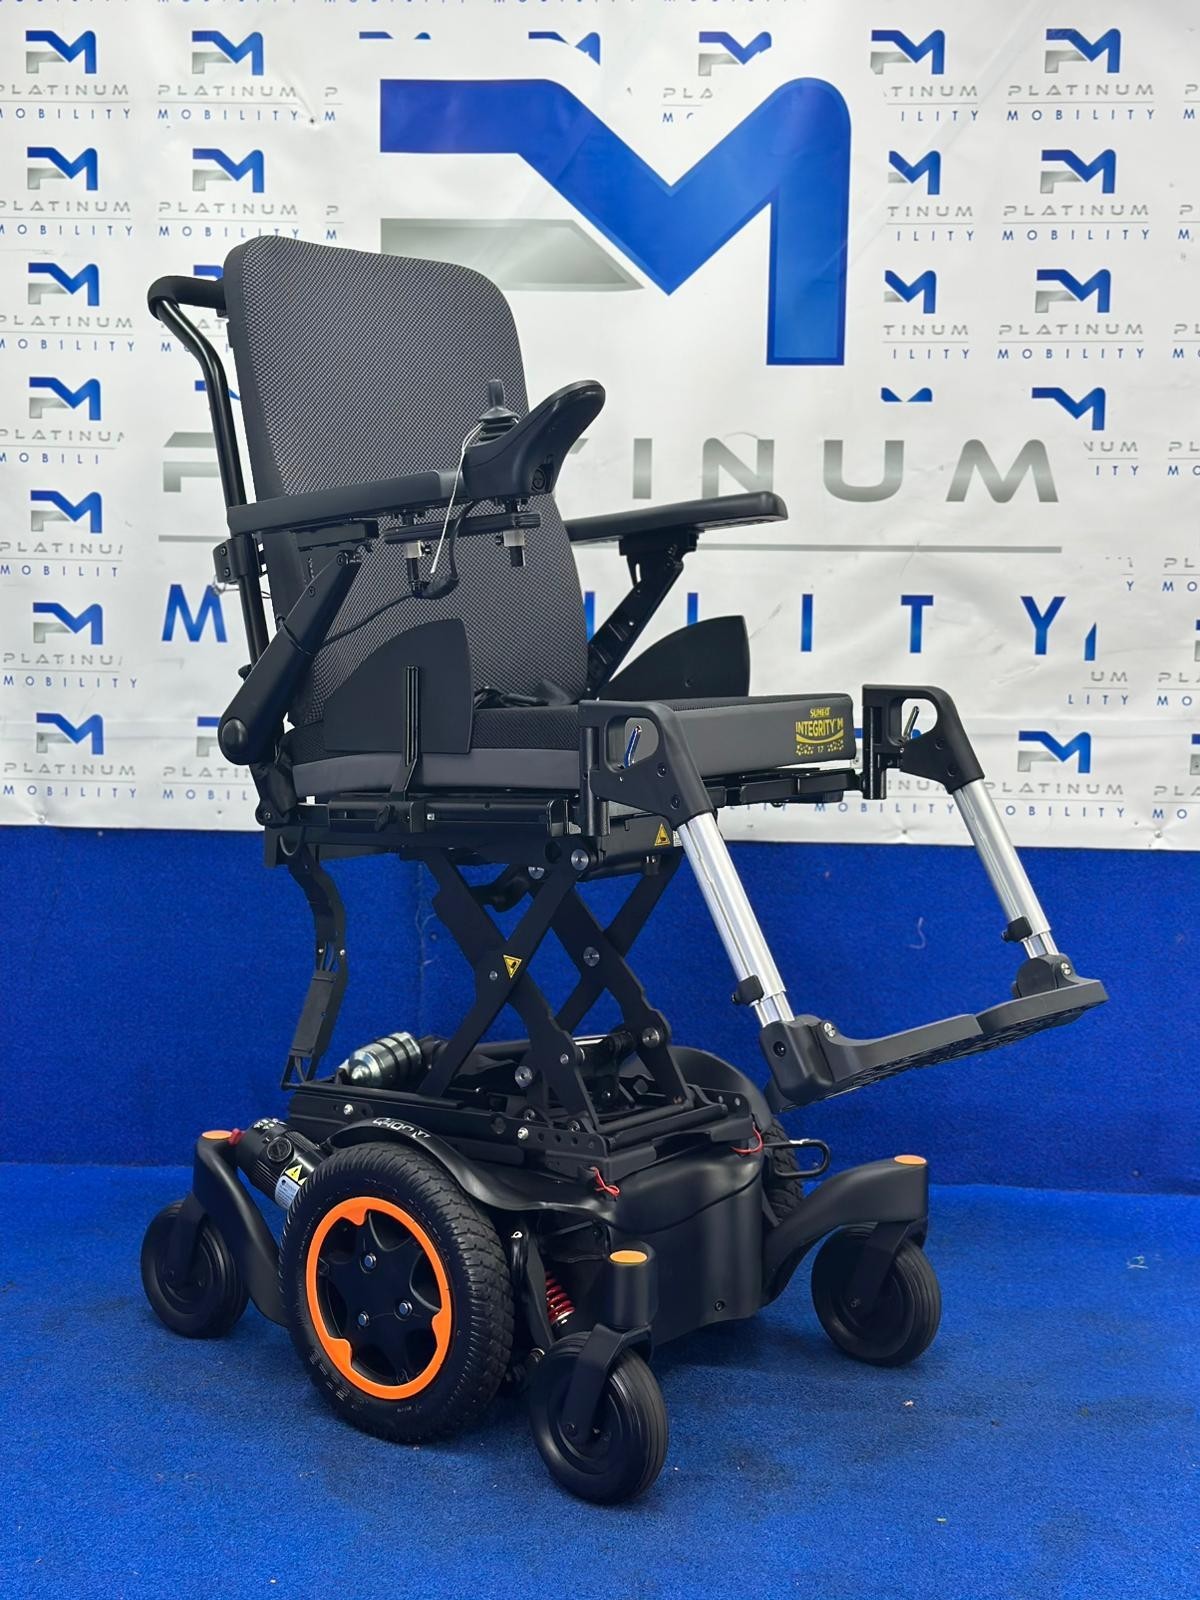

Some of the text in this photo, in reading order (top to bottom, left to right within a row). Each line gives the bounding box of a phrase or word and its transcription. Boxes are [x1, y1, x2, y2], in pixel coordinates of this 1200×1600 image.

[157, 84, 298, 97] PLATINUM
[884, 85, 978, 97] TINUM
[1007, 84, 1154, 97] PLATINUM
[0, 108, 131, 120] OBILITY
[157, 108, 299, 121] MOBILITY
[1006, 109, 1154, 121] MOBILITY
[158, 201, 298, 215] PLATINUM
[1003, 204, 1149, 217] PLATINUM
[158, 226, 300, 239] MOBILITY
[1002, 229, 1150, 241] MOBILITY
[998, 323, 1144, 335] PLATINUM
[997, 348, 1144, 360] MOBILITY
[1, 542, 123, 555] PLATINU
[4, 652, 122, 667] PLATINU
[3, 675, 137, 688] MOBILITY
[4, 762, 136, 776] PLATINUM
[3, 785, 137, 798] MOBILITY
[986, 782, 1124, 795] PLATINUM
[1005, 805, 1125, 817] OBILITY
